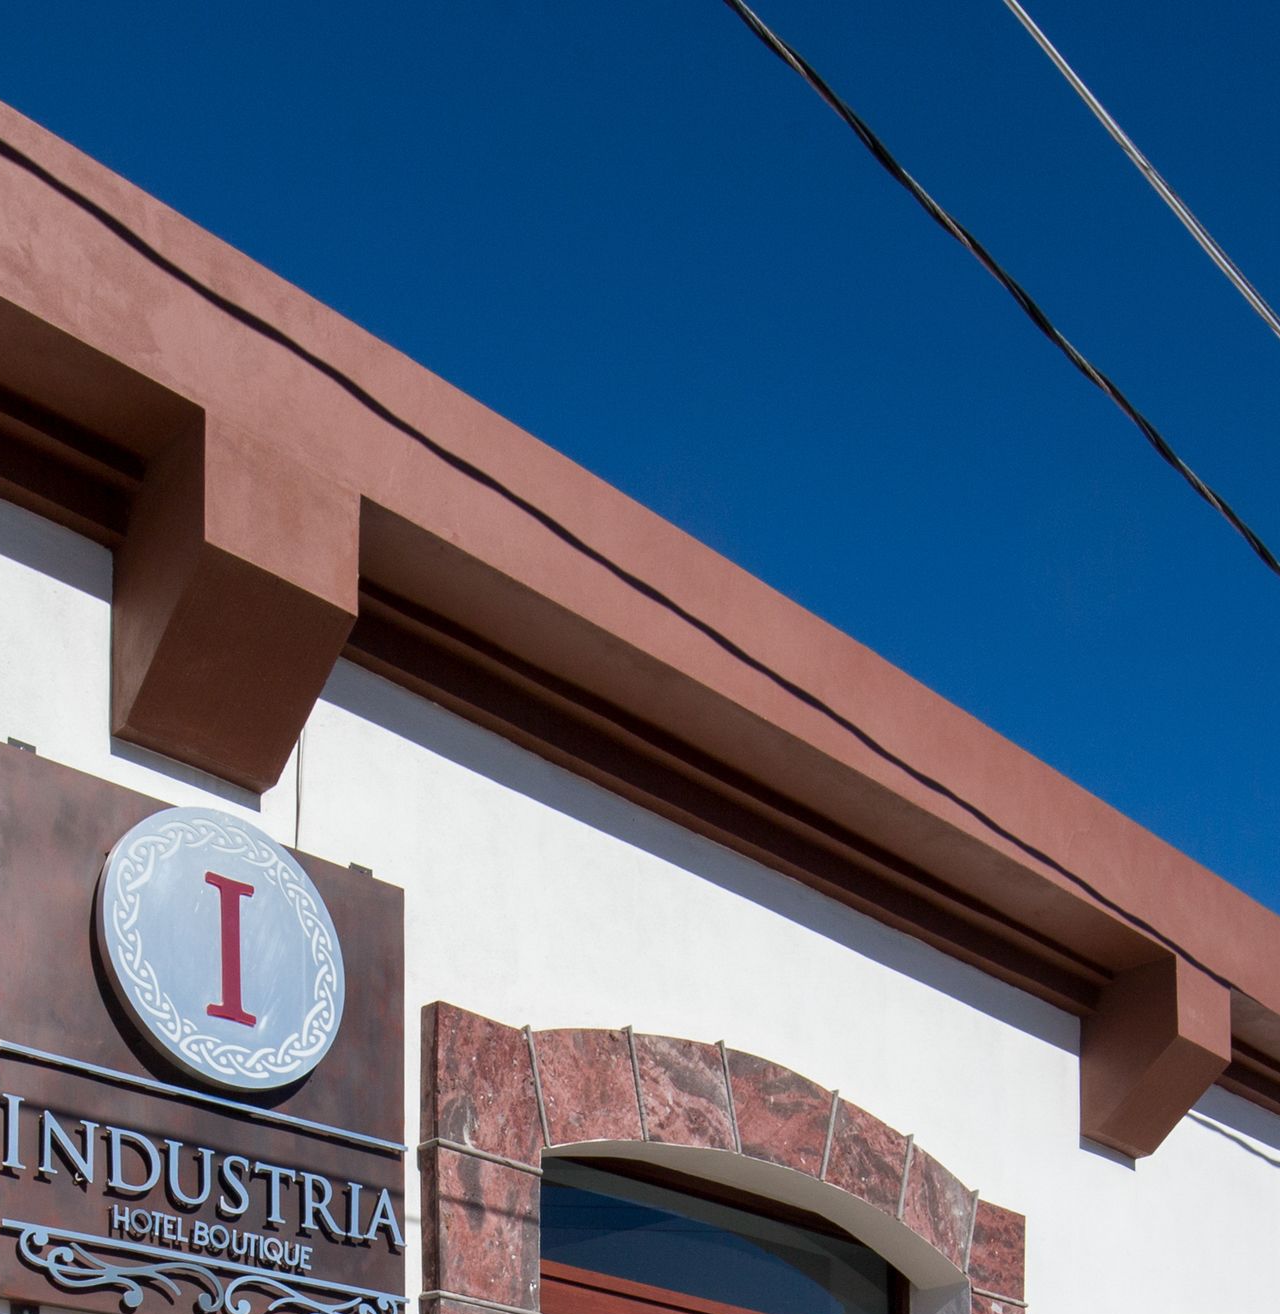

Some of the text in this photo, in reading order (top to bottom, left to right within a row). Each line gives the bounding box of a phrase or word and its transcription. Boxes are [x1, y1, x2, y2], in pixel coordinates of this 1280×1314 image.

[204, 871, 257, 1027] I
[1, 1093, 407, 1248] INDUSTRIA
[113, 1204, 313, 1270] HOTEL BOUTIQUE
